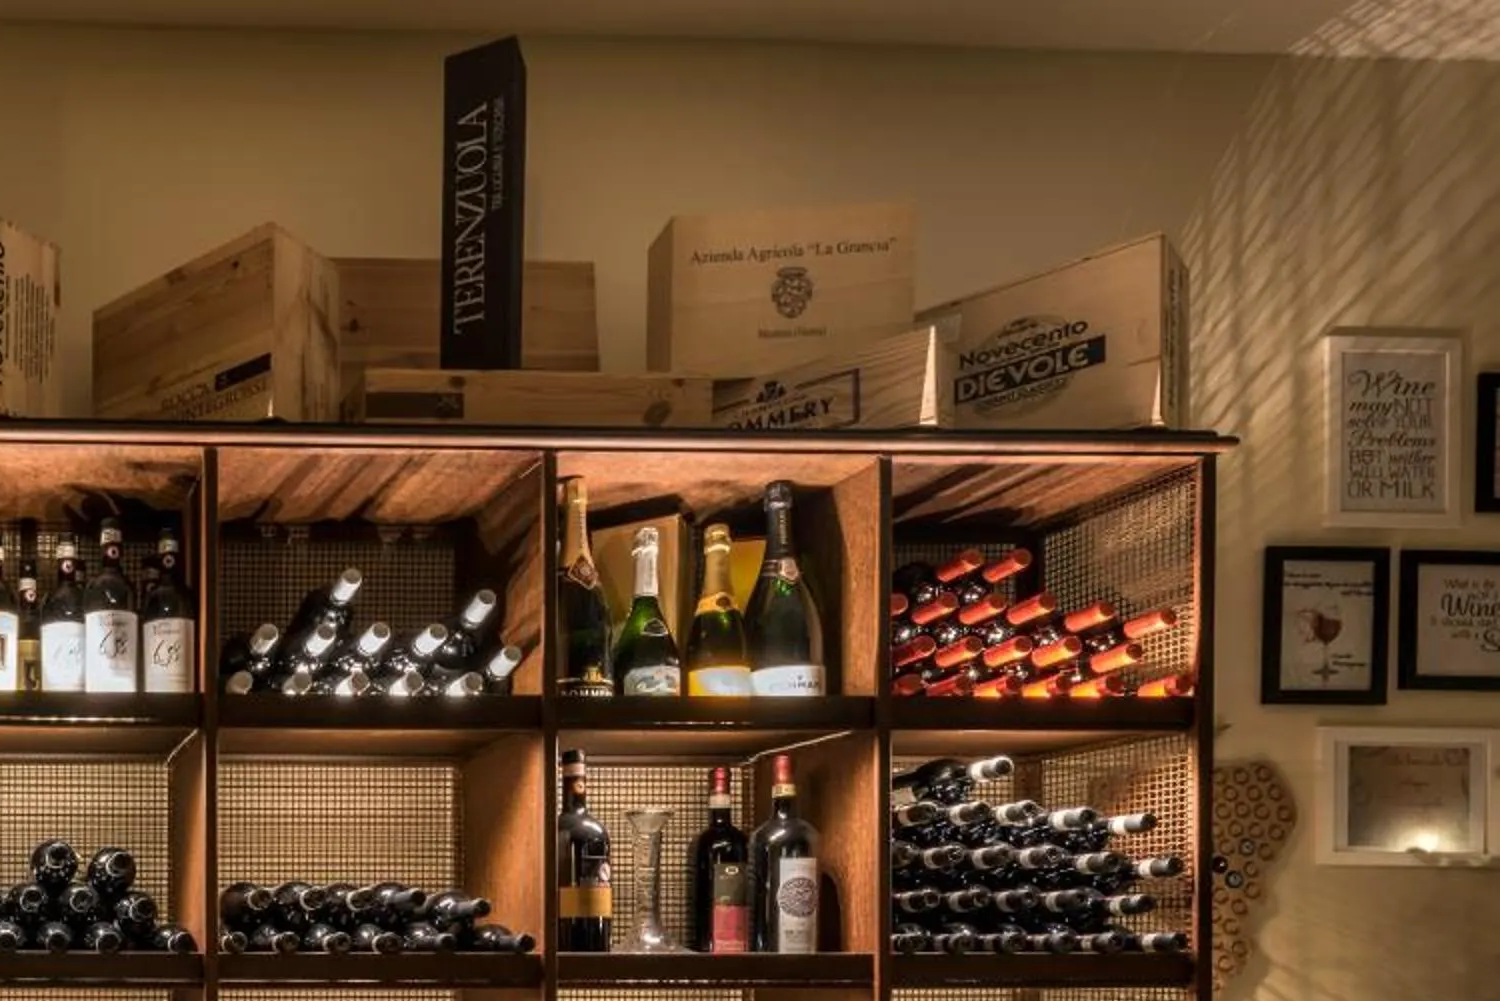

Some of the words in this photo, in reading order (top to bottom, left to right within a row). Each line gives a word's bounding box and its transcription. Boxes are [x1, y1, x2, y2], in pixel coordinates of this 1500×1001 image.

[454, 102, 487, 334] TERENZUOLA
[690, 249, 744, 265] Azienda
[747, 246, 804, 262] Agricola
[959, 320, 1088, 370] Novecento
[957, 343, 1090, 401] DIEVOLE
[1347, 368, 1436, 397] Wine
[728, 397, 835, 430] OMMERY
[1349, 401, 1392, 416] may
[1347, 480, 1373, 498] OR
[1380, 480, 1435, 500] MILK
